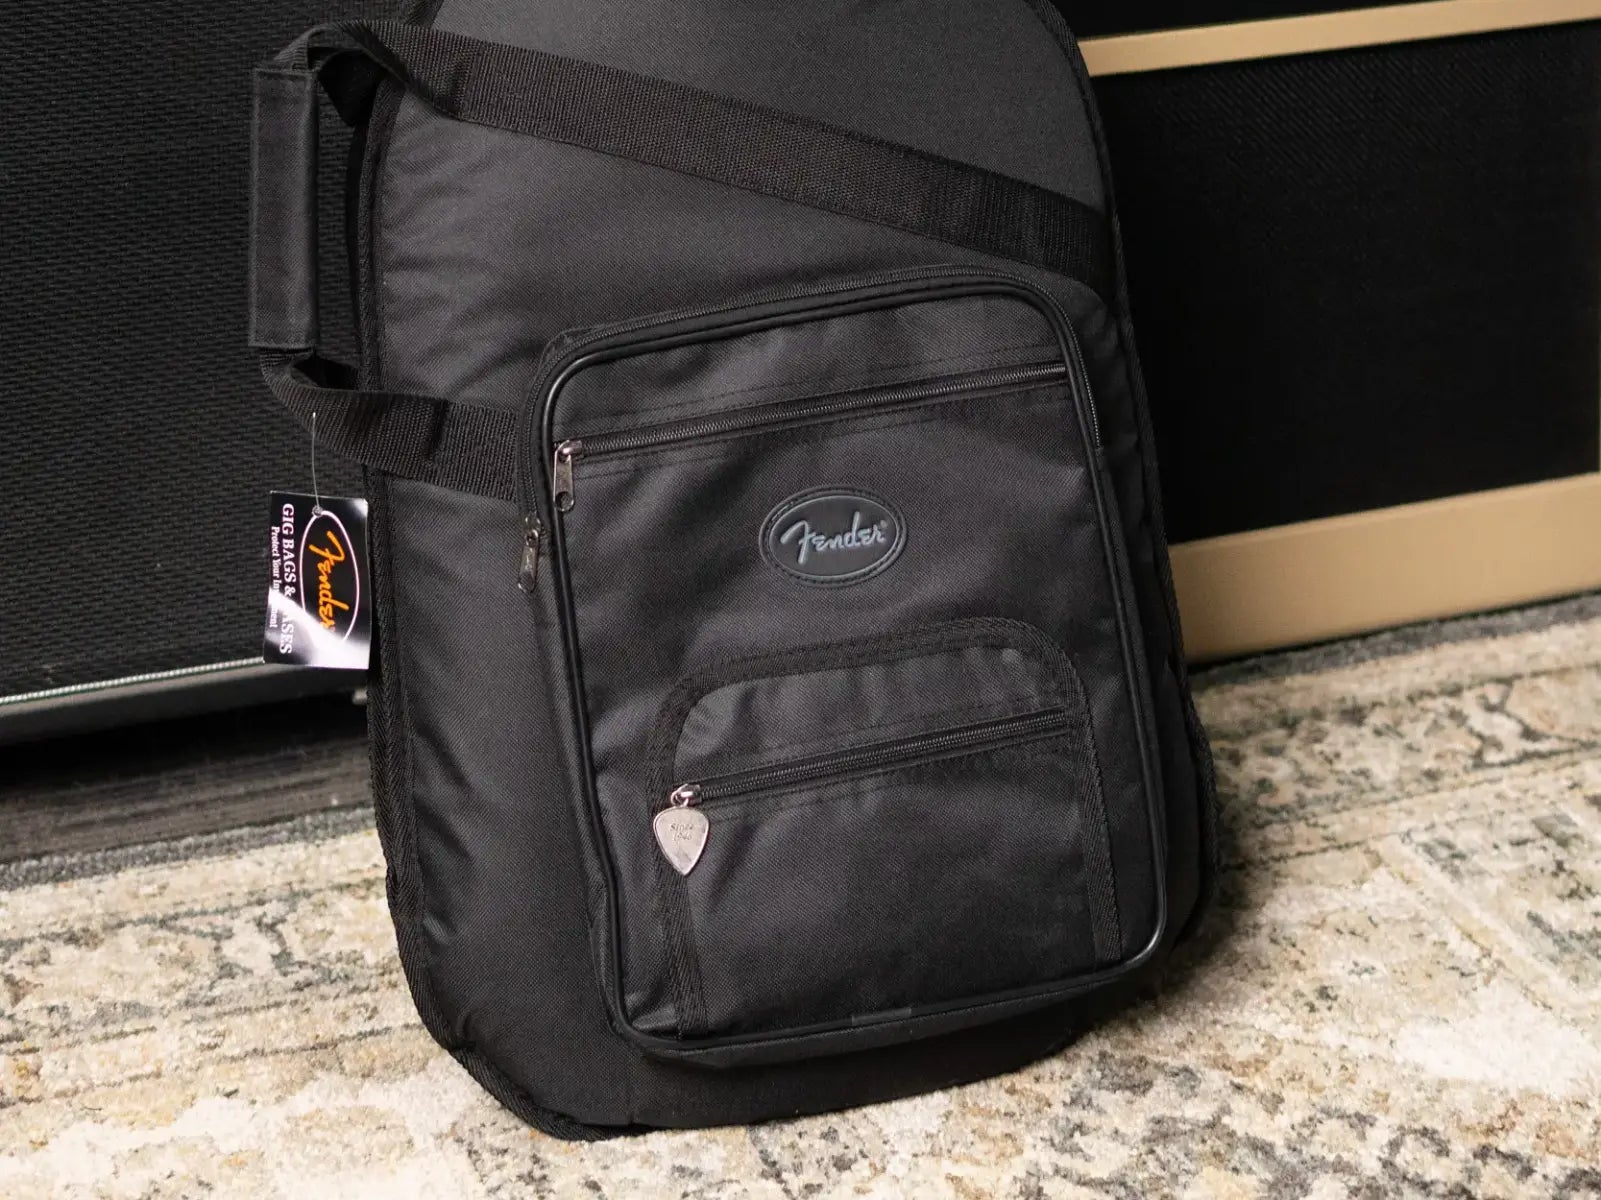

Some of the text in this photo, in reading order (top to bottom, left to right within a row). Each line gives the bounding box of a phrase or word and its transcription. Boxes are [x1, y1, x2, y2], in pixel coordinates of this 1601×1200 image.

[281, 503, 295, 535] GIG
[271, 526, 281, 557] Protect
[780, 511, 886, 565] Fender
[272, 558, 281, 579] Your
[282, 538, 296, 583] BAGS
[284, 585, 296, 597] &
[308, 530, 350, 630] Fender
